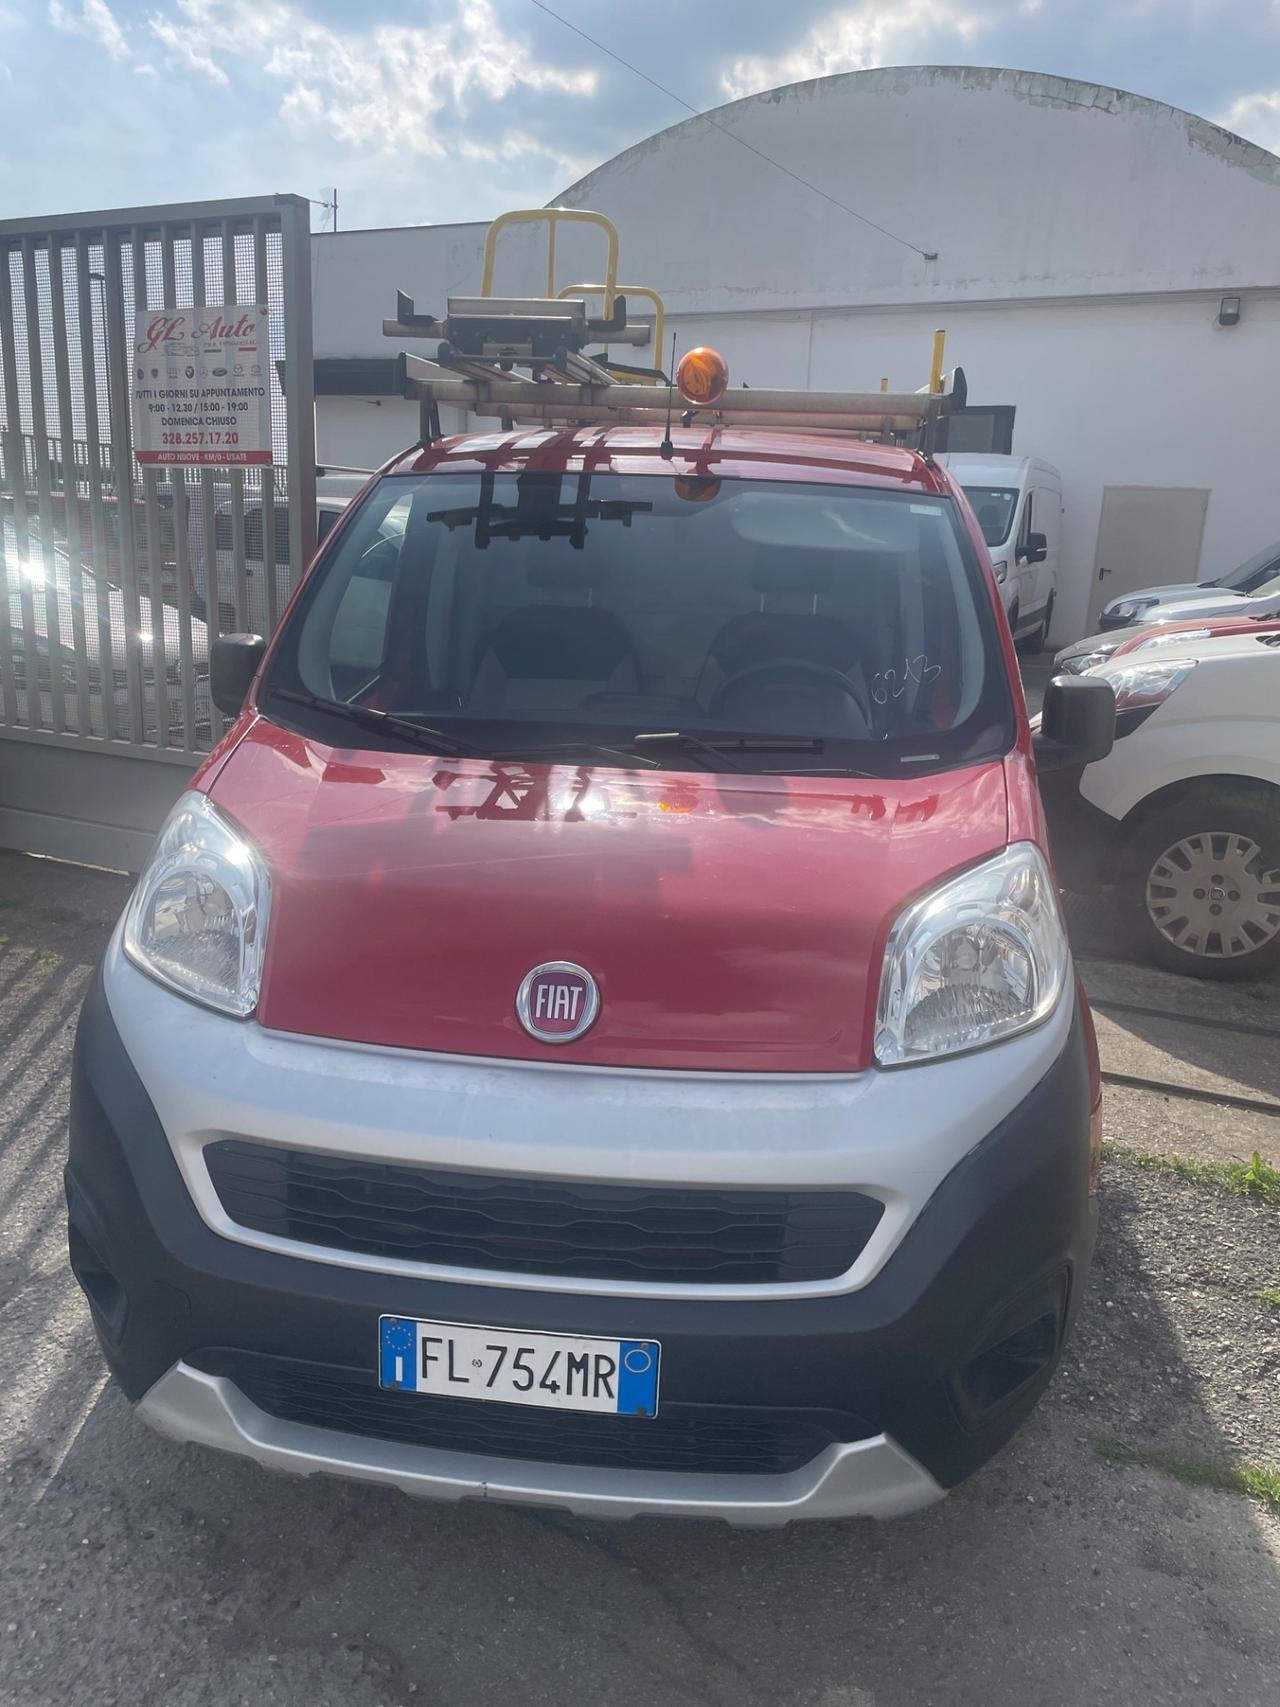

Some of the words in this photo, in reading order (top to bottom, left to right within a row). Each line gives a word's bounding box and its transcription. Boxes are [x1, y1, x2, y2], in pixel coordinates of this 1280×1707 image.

[191, 314, 256, 340] Auto
[159, 389, 187, 399] GIORNI
[190, 389, 199, 398] SU
[201, 387, 265, 398] APPUNTAMENTO
[148, 403, 165, 412] 9:00
[172, 403, 192, 412] 12.30
[200, 402, 220, 412] 15:00
[227, 402, 248, 411] 19:00
[161, 417, 202, 426] DOMENICA
[206, 416, 237, 426] CHIUSO
[162, 432, 239, 444] 328.257.17.20
[158, 453, 176, 461] AUTO
[176, 453, 200, 461] NUOVE
[227, 453, 247, 461] USATE
[535, 984, 583, 1020] FIAT
